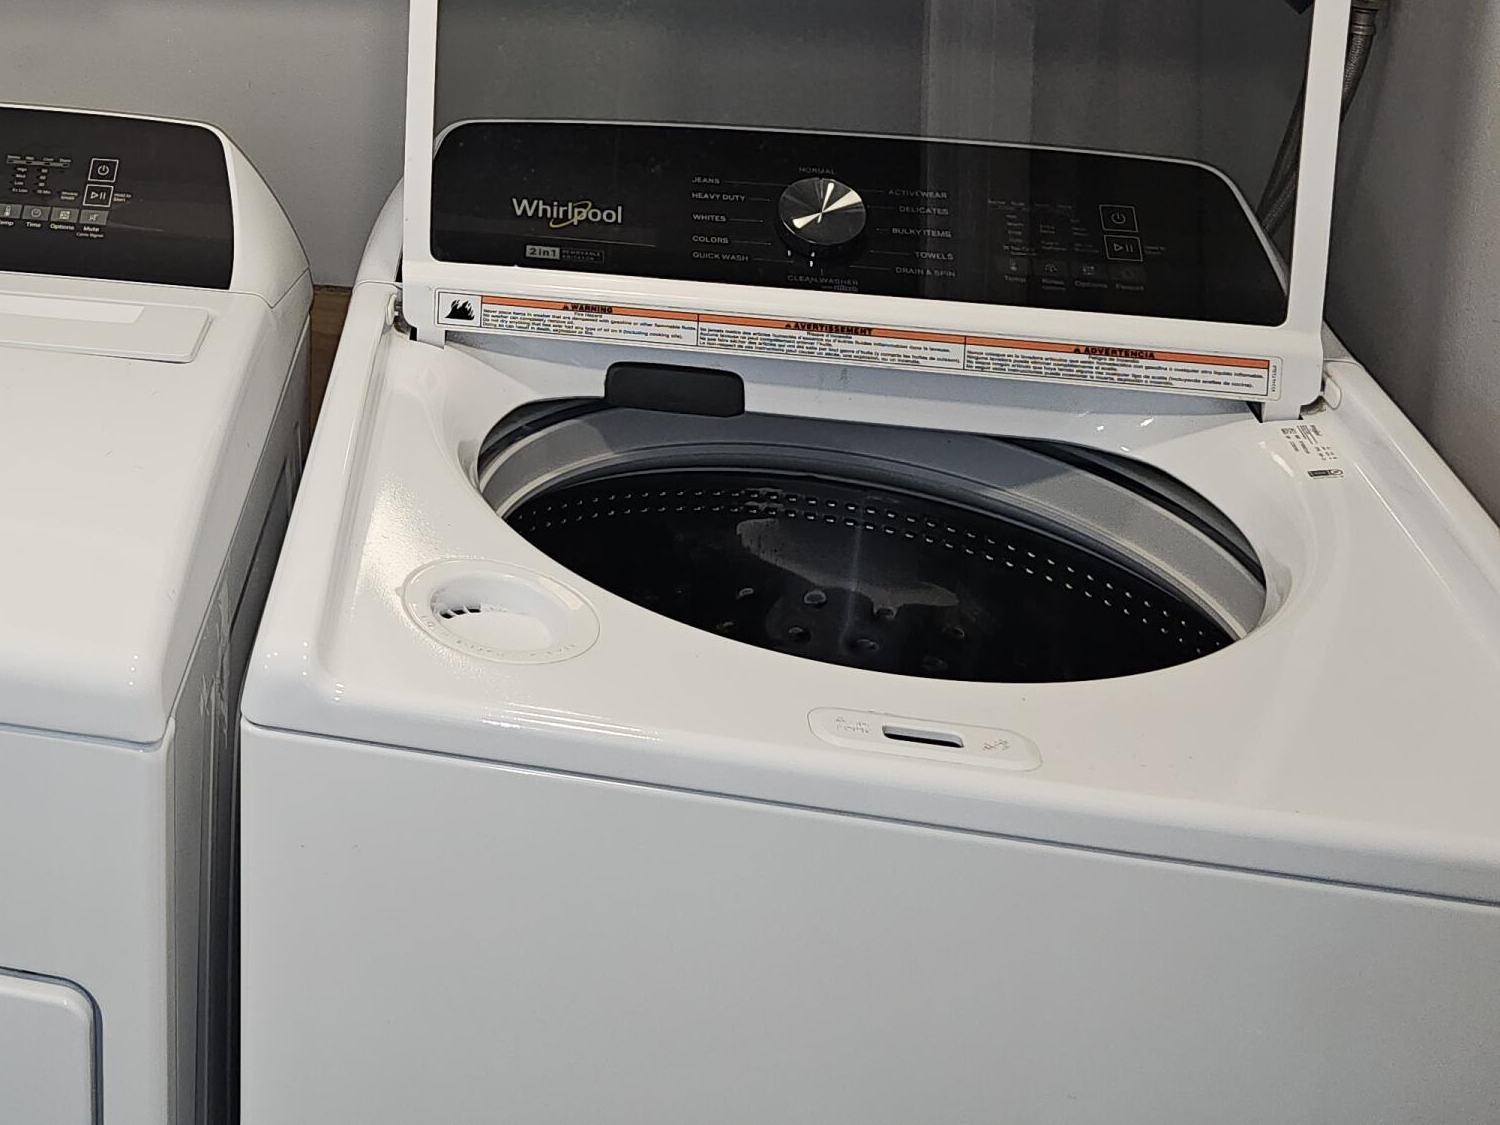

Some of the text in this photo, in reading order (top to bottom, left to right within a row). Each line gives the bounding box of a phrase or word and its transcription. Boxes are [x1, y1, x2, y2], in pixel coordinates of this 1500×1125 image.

[798, 166, 836, 176] NORMAL
[692, 176, 720, 185] JEANS
[692, 192, 746, 202] HEAVY DUTY
[888, 189, 948, 199] ACTIVEWEAR
[512, 197, 622, 227] Whirlpool
[899, 206, 949, 215] DELICATES
[692, 214, 726, 222] WHITES
[892, 227, 952, 238] BULKY ITEMS
[692, 236, 730, 244] COLORS
[692, 252, 749, 262] QUICK WASH
[915, 251, 954, 260] TOWELS
[896, 266, 924, 275] DRAIN
[788, 274, 859, 286] CLEAN WASHER
[571, 303, 613, 314] WARNING
[793, 322, 874, 336] AVERTISSEMENT
[1084, 346, 1156, 360] ADVERTENCIA
